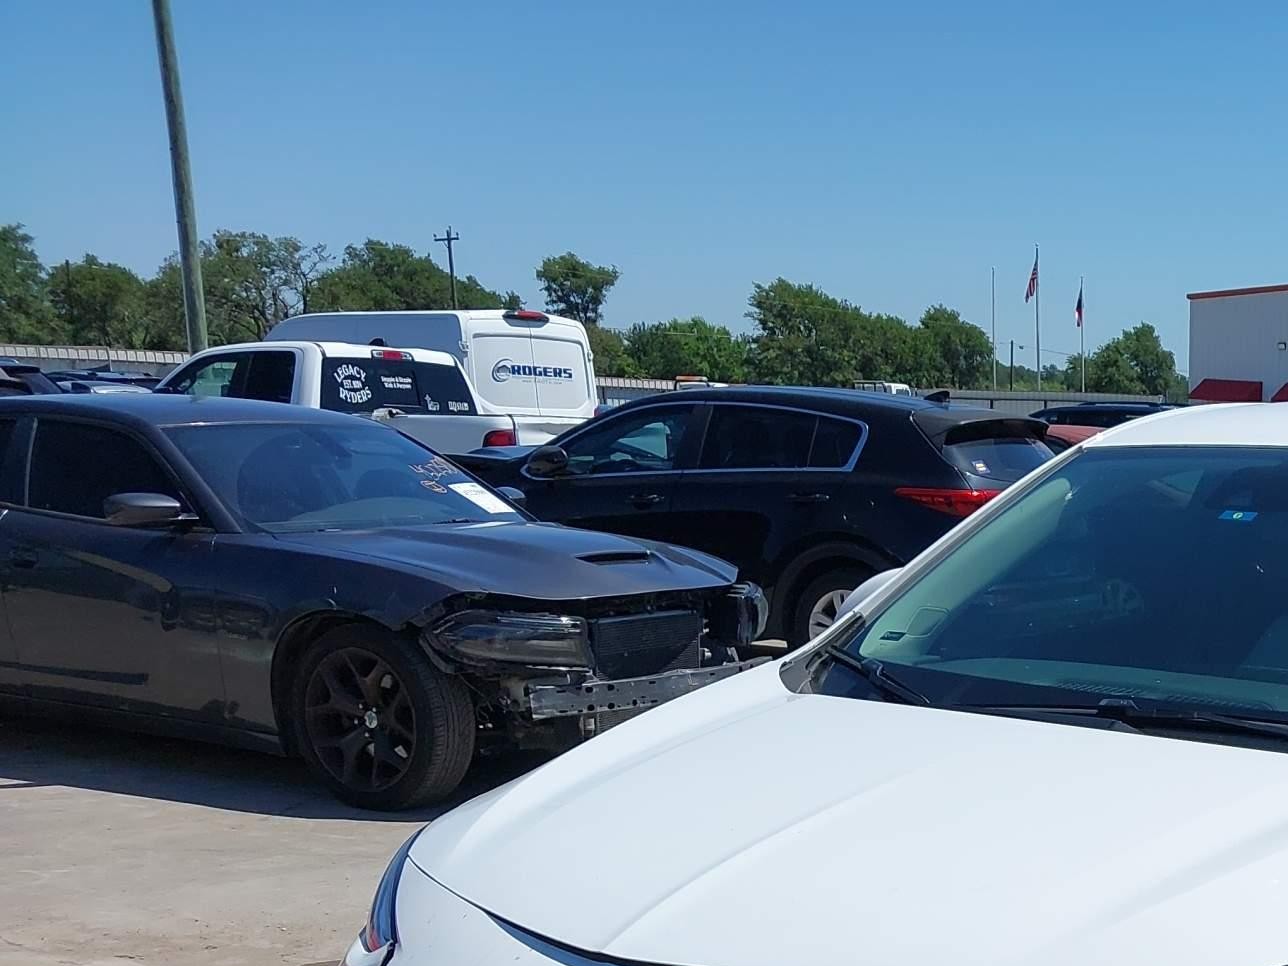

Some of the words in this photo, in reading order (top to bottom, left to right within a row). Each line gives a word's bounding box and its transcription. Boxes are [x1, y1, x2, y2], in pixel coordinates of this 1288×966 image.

[333, 364, 367, 383] LEGACY
[510, 364, 573, 379] ROGERS
[339, 386, 372, 404] RYDERS
